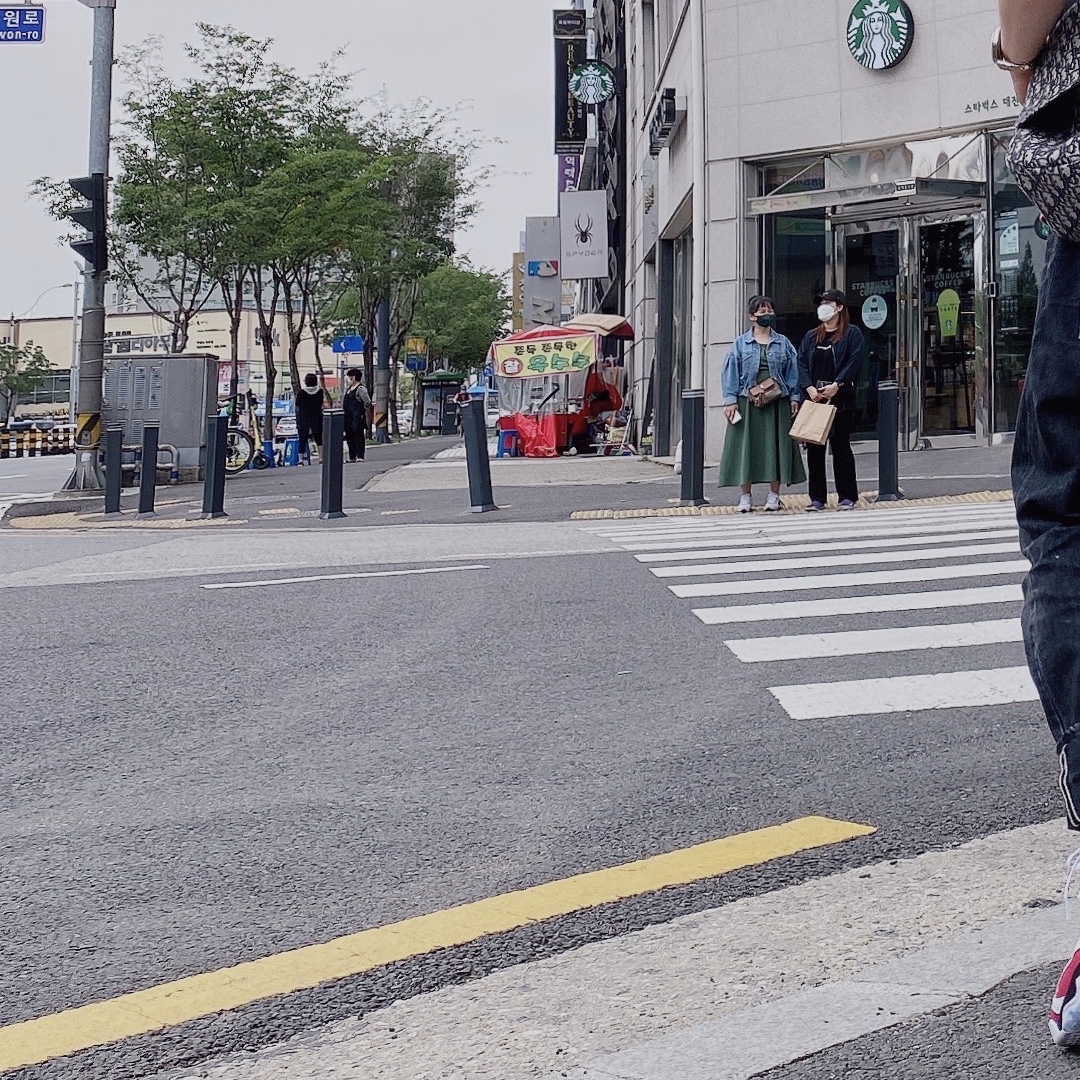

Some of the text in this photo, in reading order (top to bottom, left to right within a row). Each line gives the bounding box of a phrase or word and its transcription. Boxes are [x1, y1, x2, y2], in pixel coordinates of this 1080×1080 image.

[964, 99, 998, 114] 스타벅스
[565, 249, 604, 258] SPYDER
[527, 350, 591, 373] 옥수수
